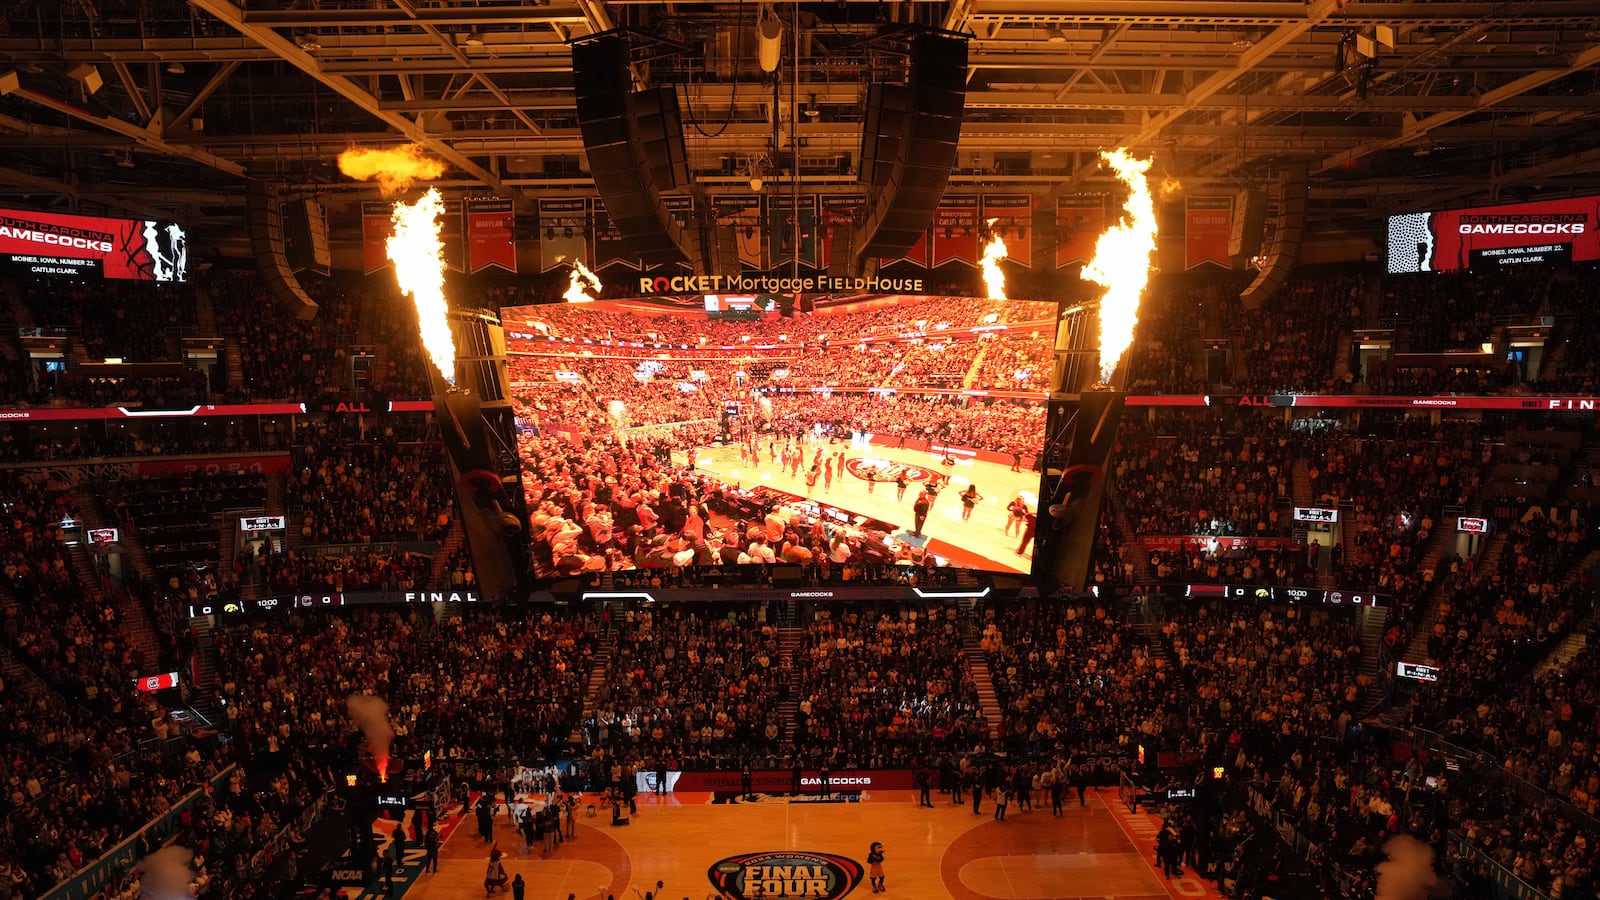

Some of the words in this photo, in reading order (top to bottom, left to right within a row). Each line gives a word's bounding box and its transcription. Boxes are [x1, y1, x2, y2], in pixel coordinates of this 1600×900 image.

[1460, 216, 1507, 224] SOUTH
[1510, 214, 1585, 223] CAROLINA
[39, 224, 112, 241] CAROLINA
[1459, 223, 1585, 234] GAMECOCKS
[1481, 249, 1506, 257] MOINES,
[11, 255, 40, 263] MOINES,
[1522, 256, 1545, 264] CLARK.
[31, 266, 56, 274] CAITLIN
[640, 276, 722, 293] ROCKET
[727, 275, 814, 294] Mortgage
[1238, 395, 1274, 406] ALL
[335, 402, 370, 412] ALL
[405, 592, 477, 602] FINAL
[1286, 589, 1308, 597] 10:00
[257, 599, 278, 607] 10:00
[774, 854, 829, 866] WOMEN'S
[331, 869, 363, 881] NCAA
[743, 865, 829, 880] FINAL
[742, 879, 830, 898] FOUR
